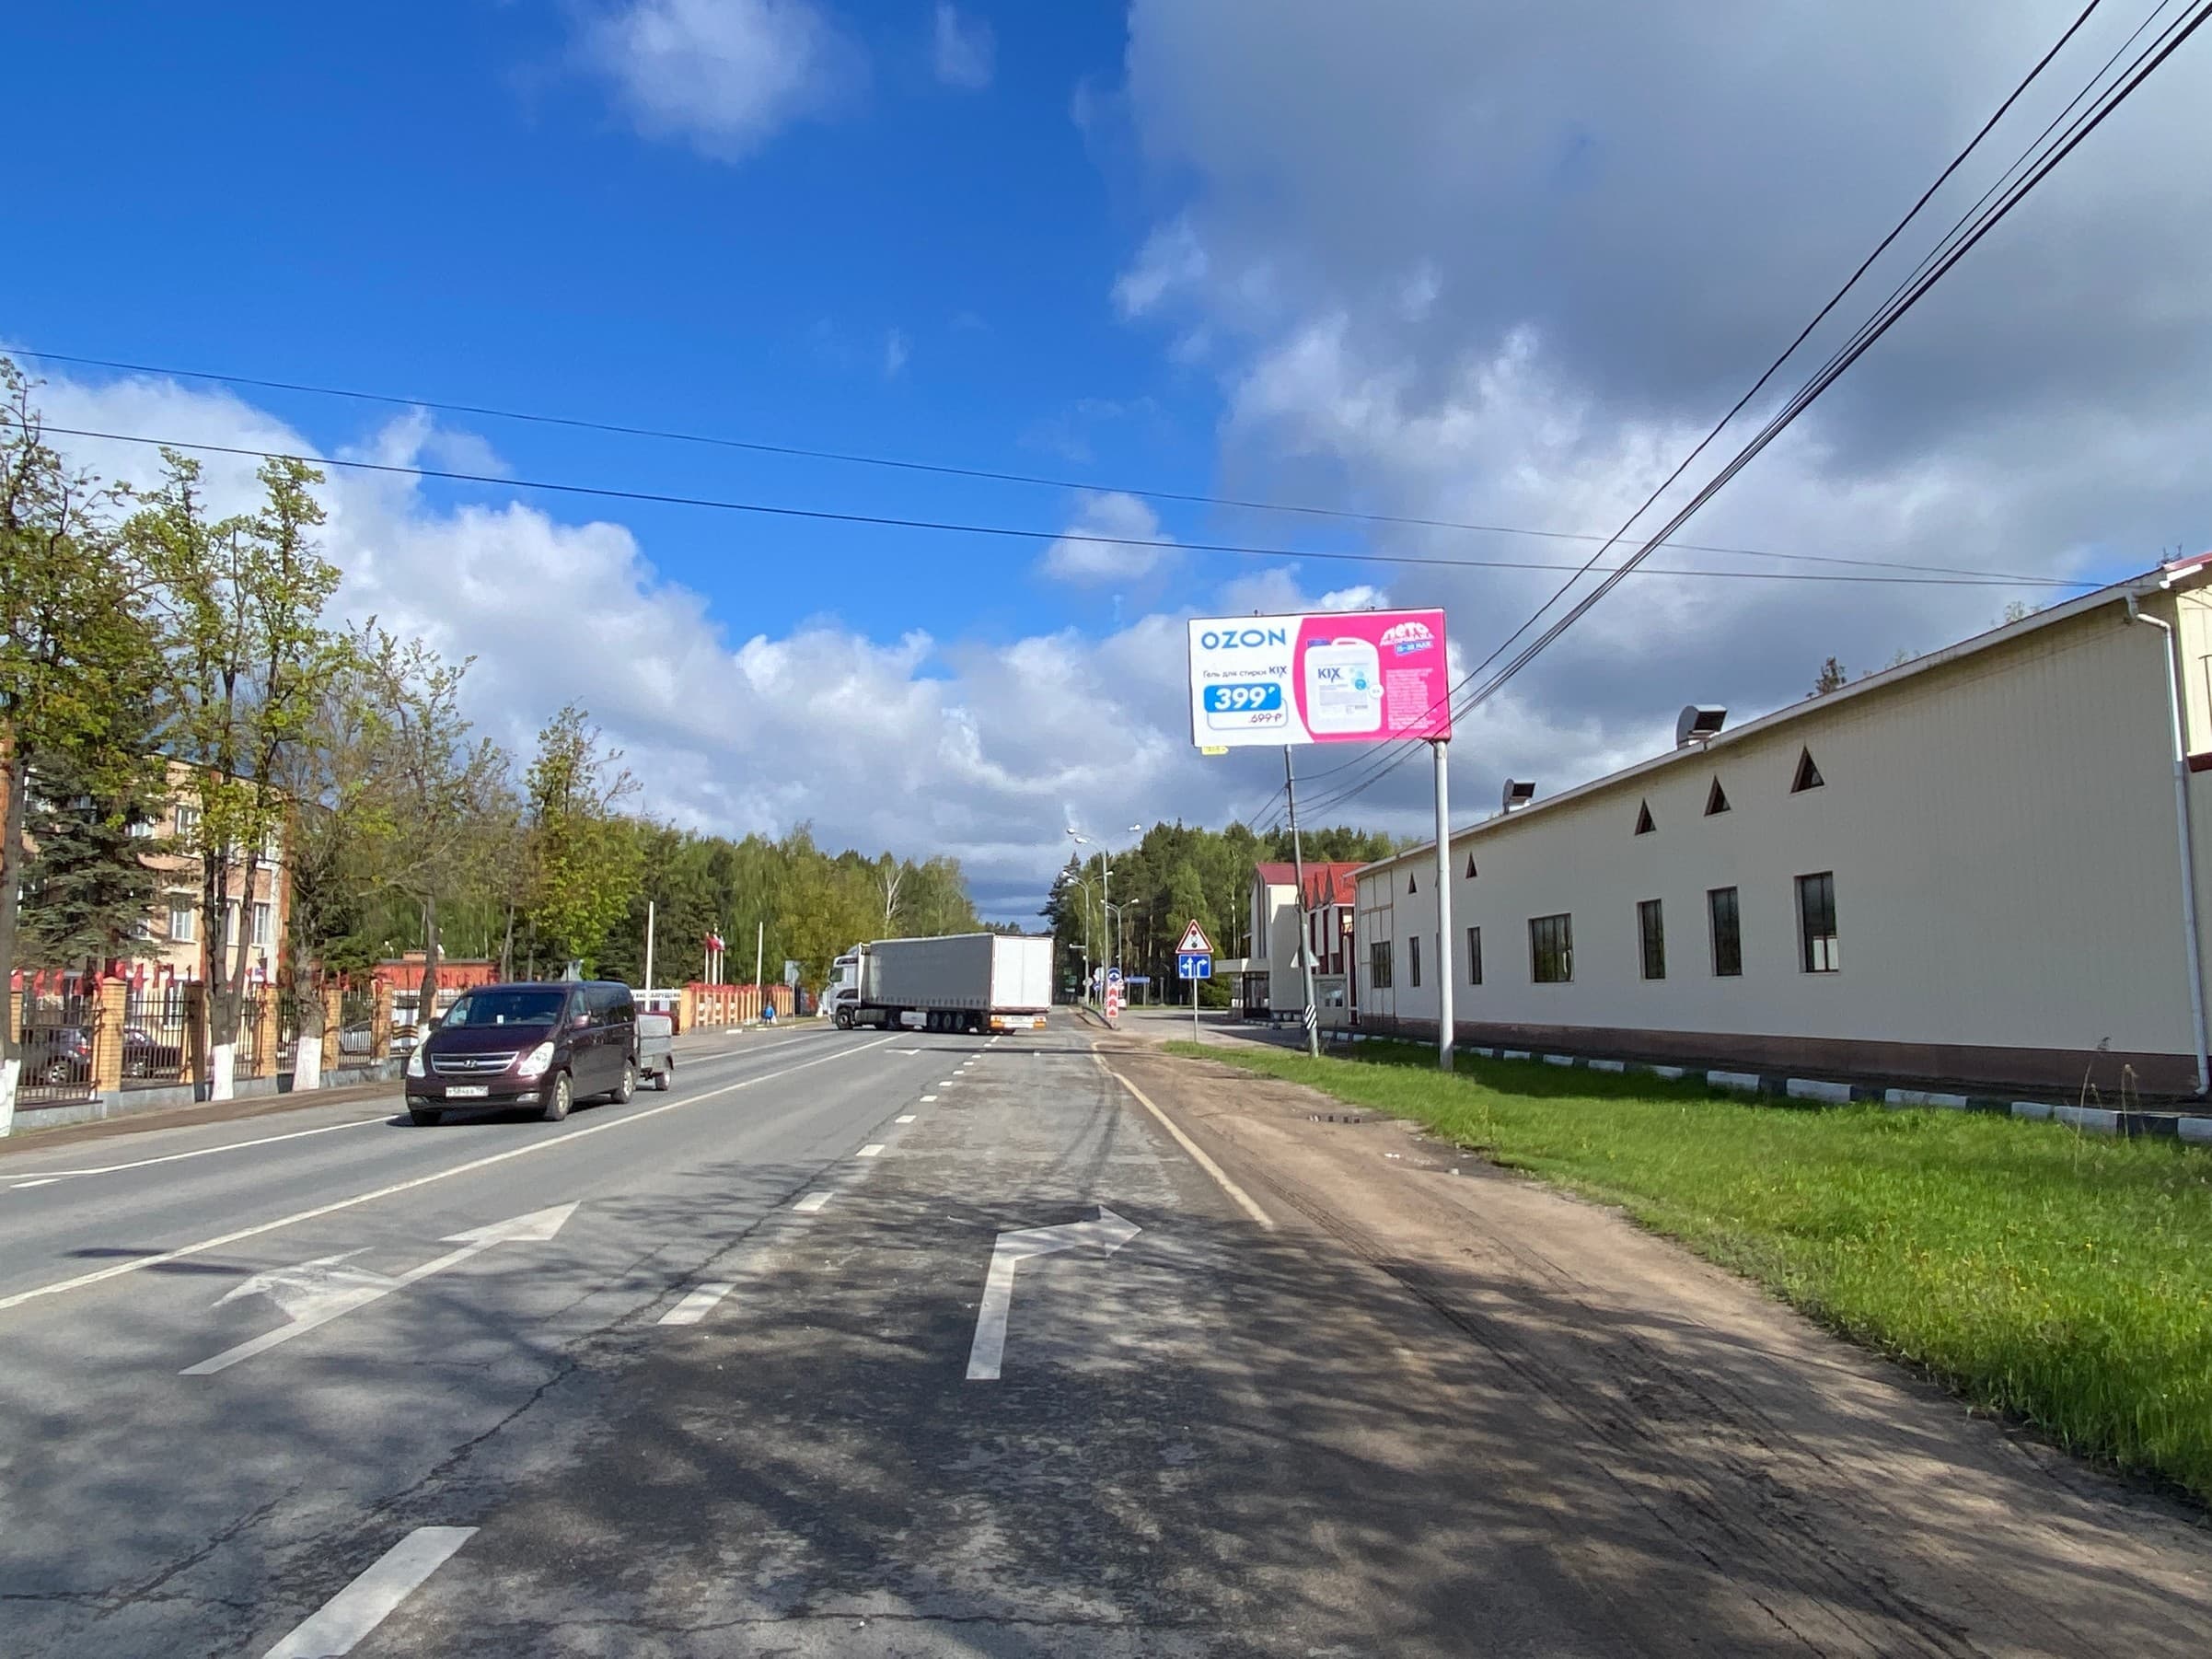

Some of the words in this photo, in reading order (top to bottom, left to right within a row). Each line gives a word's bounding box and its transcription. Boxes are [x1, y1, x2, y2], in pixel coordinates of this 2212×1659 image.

[1201, 628, 1286, 650] OZON
[1268, 666, 1287, 678] KIX
[1317, 667, 1340, 683] KIX
